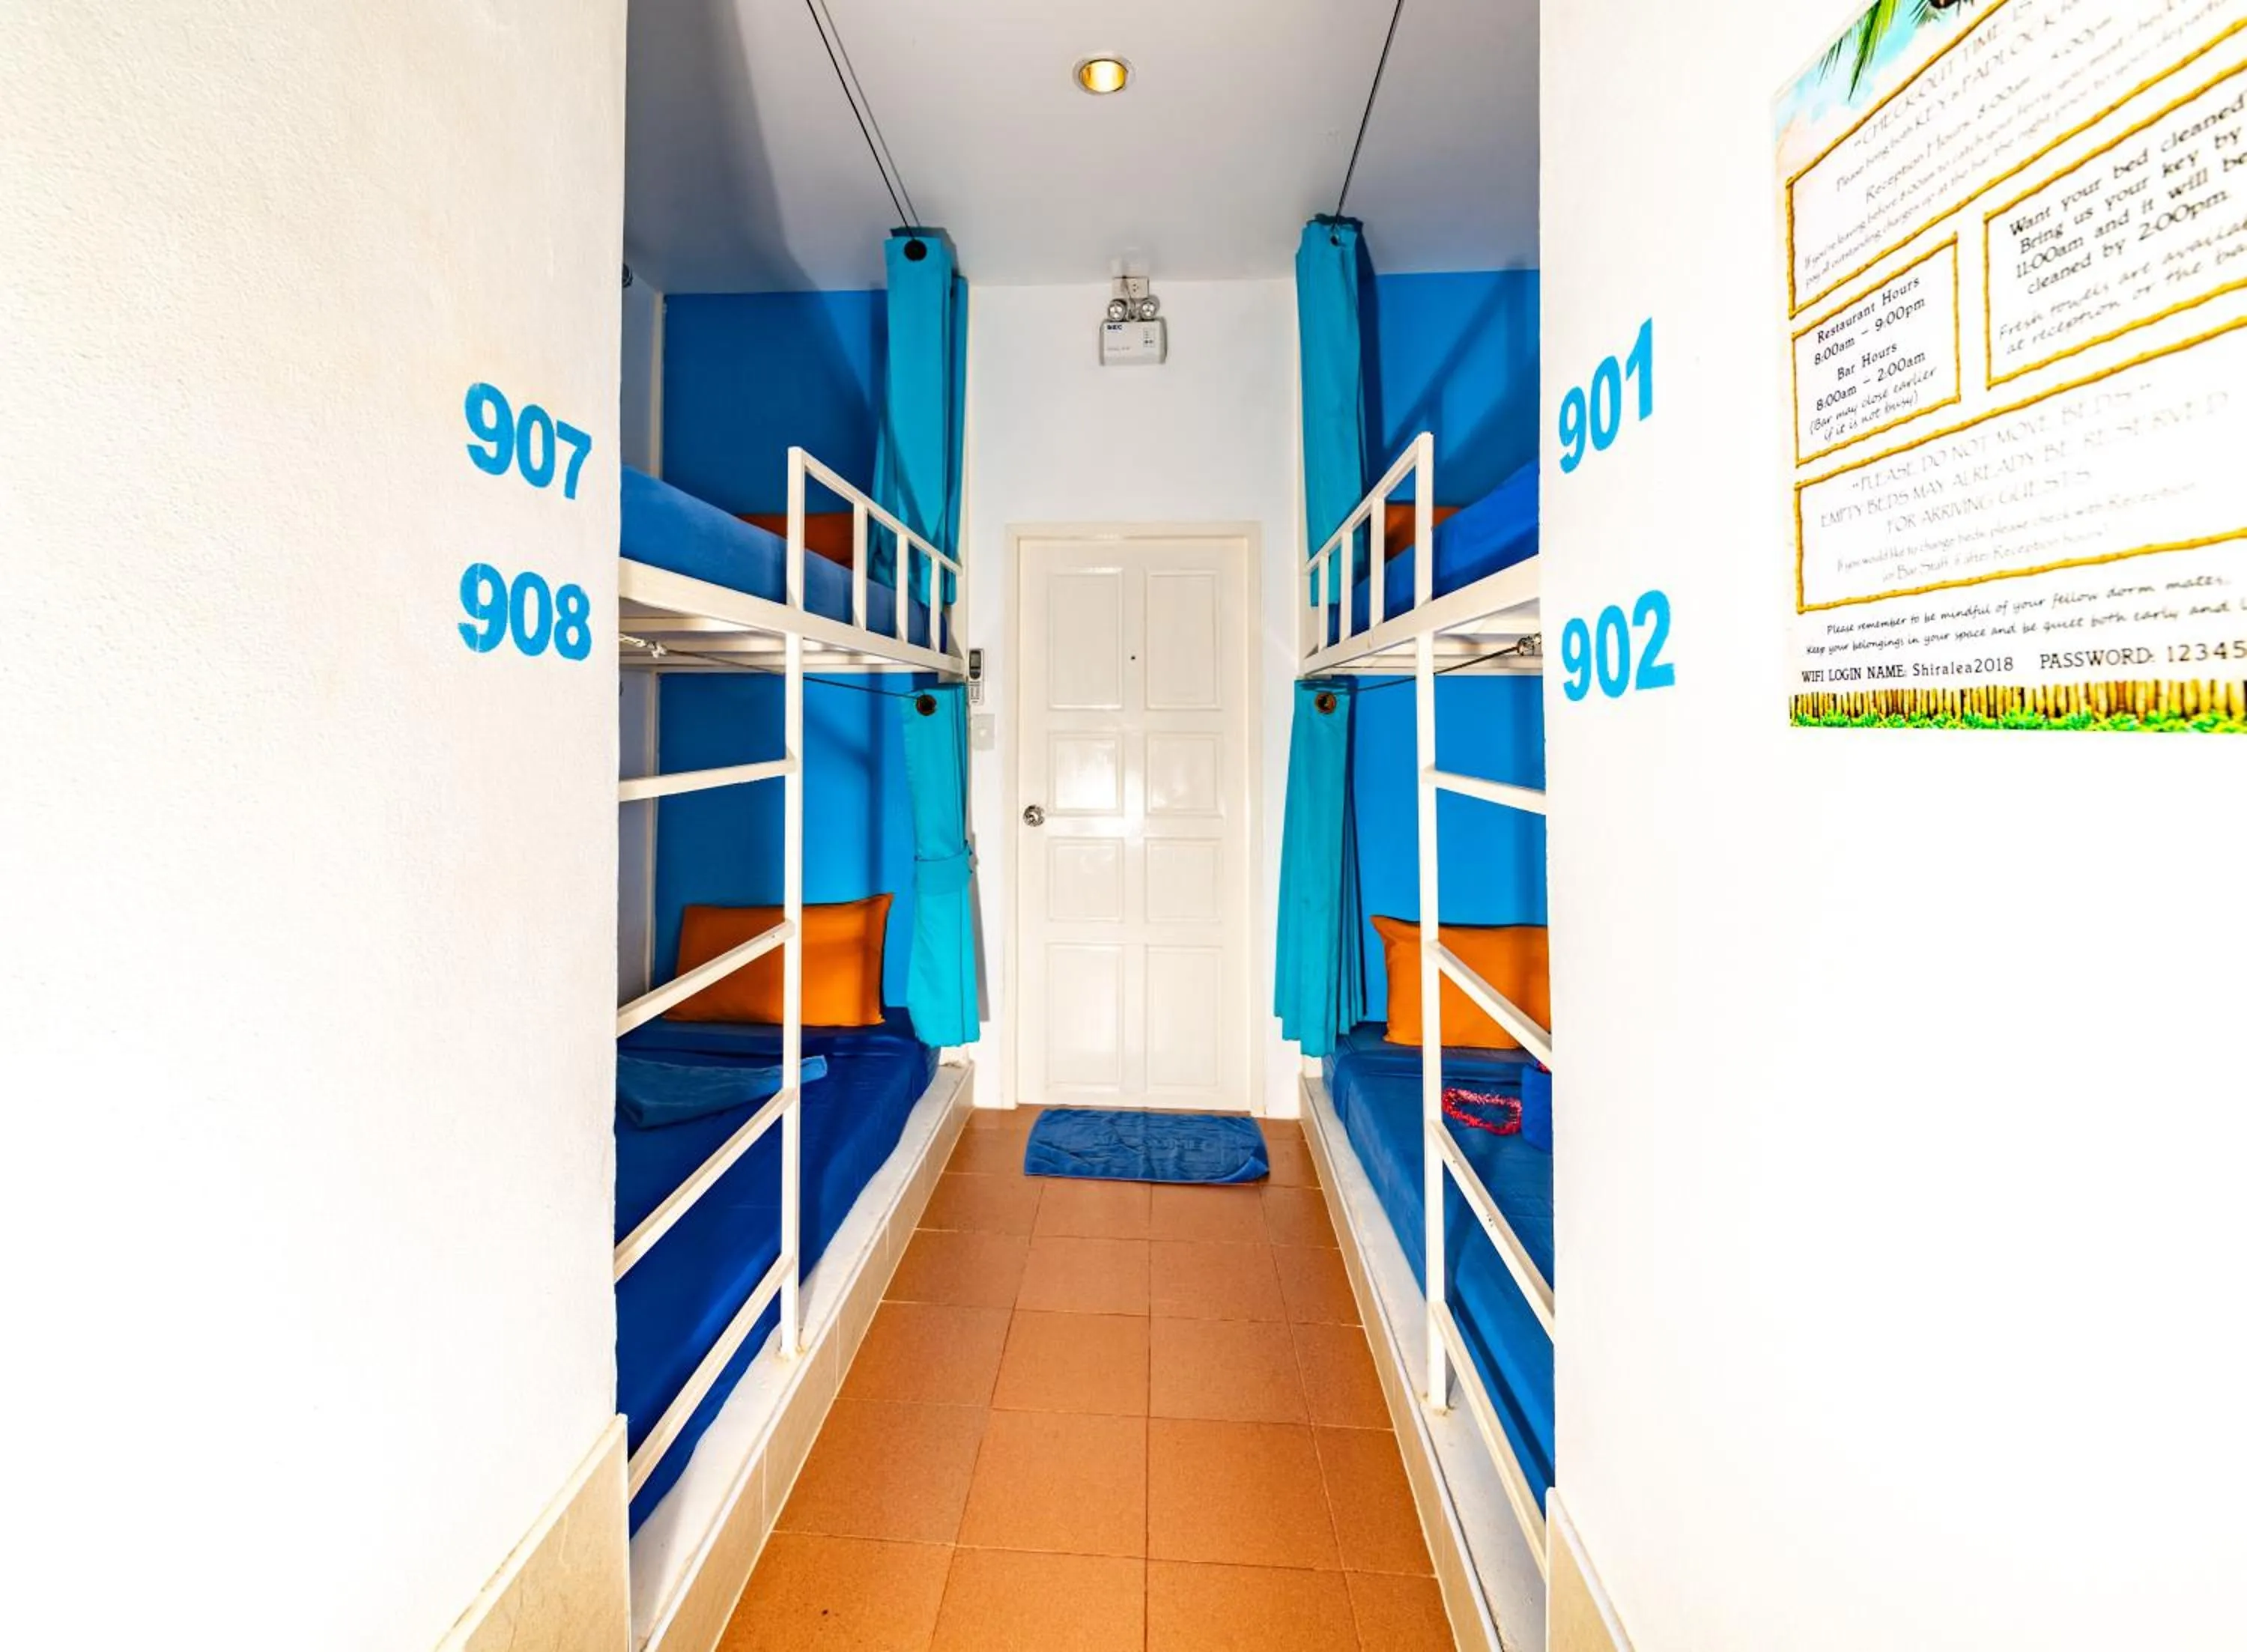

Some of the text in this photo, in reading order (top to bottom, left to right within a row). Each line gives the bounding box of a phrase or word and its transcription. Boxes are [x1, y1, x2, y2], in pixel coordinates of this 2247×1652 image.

[1866, 154, 1923, 204] Reception
[2010, 90, 2247, 236] Want your bed cleaned
[2020, 127, 2242, 255] Bring us your key by
[2094, 209, 2129, 238] and
[2141, 198, 2153, 215] it
[2167, 168, 2208, 199] will
[2028, 252, 2091, 294] cleaned
[2102, 239, 2126, 258] by
[1814, 338, 1855, 365] 8:00am
[1875, 299, 1925, 332] 9:00pm
[1816, 278, 1920, 344] Restaurant Hours
[1816, 386, 1857, 411] 8:00am
[1878, 352, 1926, 382] 2:00am
[1837, 343, 1897, 381] Bar Hours
[1559, 318, 1653, 474] 901
[1810, 416, 1832, 435] (Bar
[1836, 405, 1858, 419] may
[1862, 389, 1887, 407] close
[1825, 389, 1918, 443] if it is not busy)
[464, 383, 592, 500] 907
[1821, 505, 1863, 527] EMPTY
[1867, 491, 1909, 514] BEDS
[1887, 514, 1916, 533] FOR
[1922, 496, 1992, 523] ARRIVING
[458, 562, 592, 661] 908
[1827, 624, 1854, 635] Please
[1858, 618, 1907, 631] remember
[1911, 616, 1920, 624] to
[1924, 613, 1935, 623] be
[1941, 605, 1990, 619] mindful
[1995, 601, 2008, 616] of
[2013, 599, 2046, 614] your
[2052, 593, 2097, 609] fellow
[2106, 586, 2155, 598] dorm
[1829, 643, 1849, 655] your
[1852, 638, 1903, 651] belongings
[1924, 633, 1950, 646] your
[1955, 629, 1986, 641] space
[1991, 624, 2016, 635] and
[2022, 623, 2037, 634] be
[2189, 601, 2231, 615] and
[1562, 589, 1675, 702] 902
[1801, 669, 1824, 683] WIFI
[1828, 667, 1861, 682] LOGIN
[1912, 657, 2013, 676] Shiralea2018
